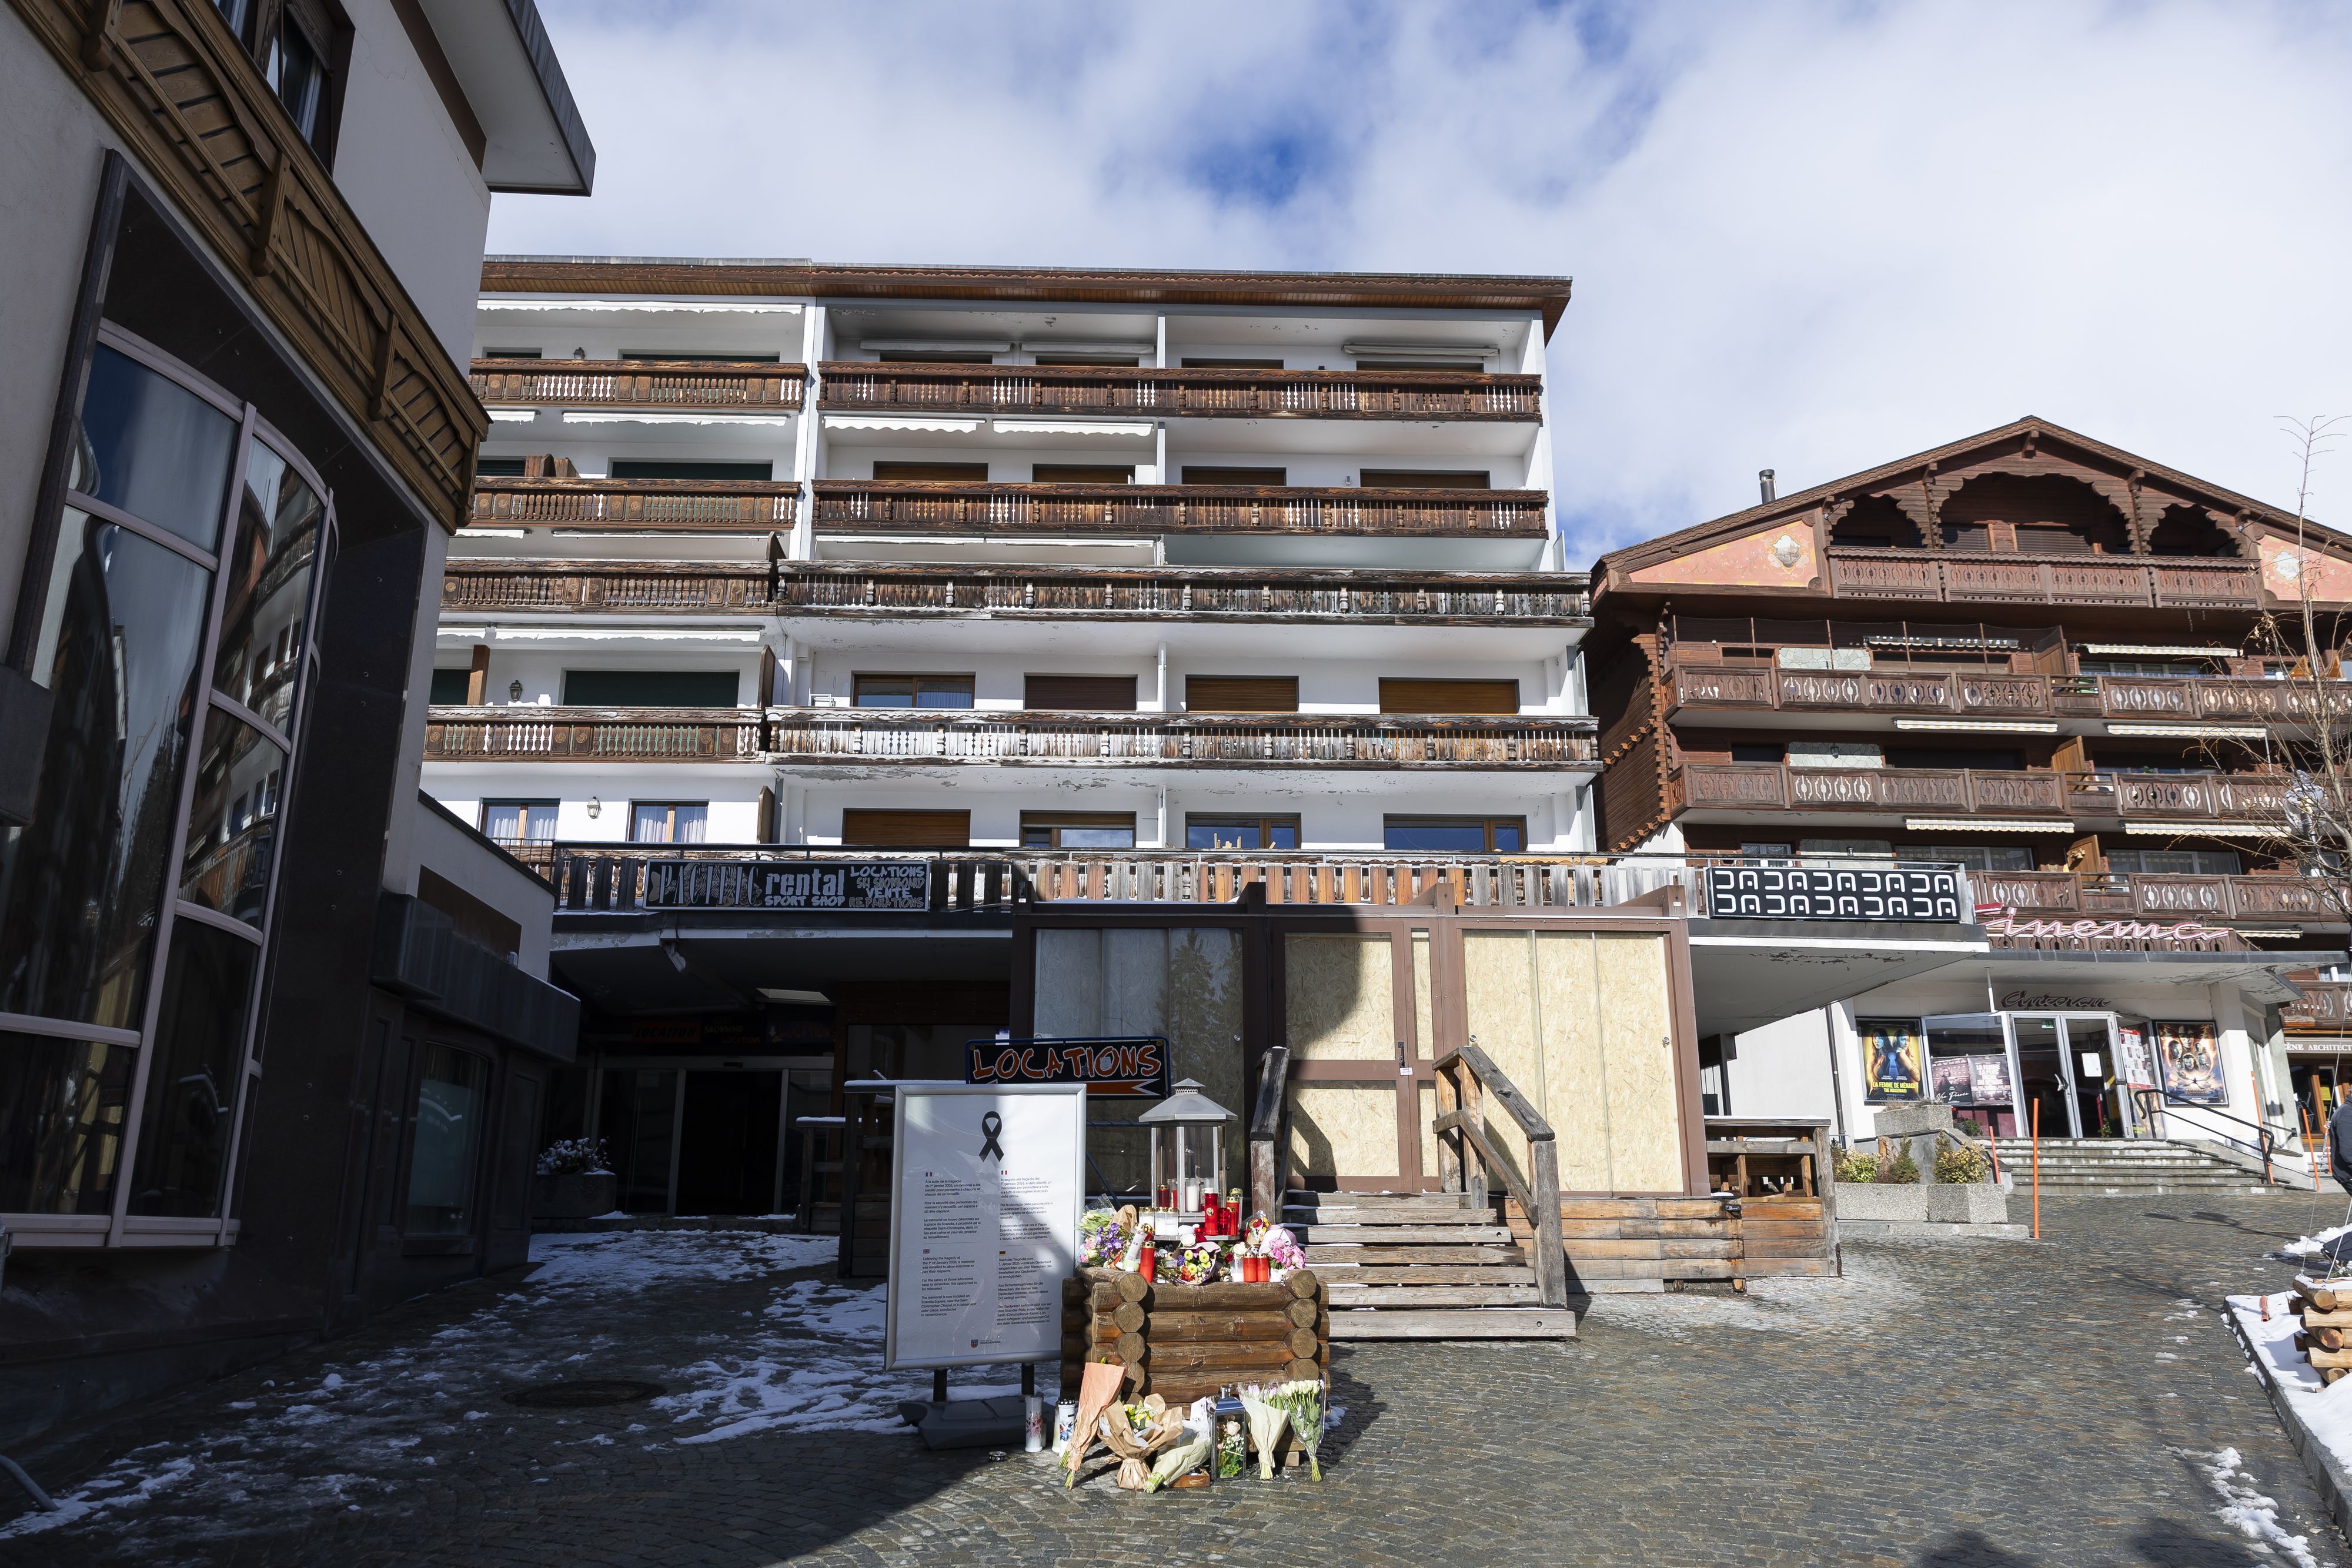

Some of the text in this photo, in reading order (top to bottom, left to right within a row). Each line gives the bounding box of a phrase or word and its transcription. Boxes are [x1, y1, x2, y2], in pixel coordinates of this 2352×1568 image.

[850, 865, 926, 877] LOCATIONS
[659, 865, 759, 905] PACIFIC
[766, 868, 845, 895] rental
[856, 877, 926, 889] SKI SNOWBOARD
[866, 887, 913, 898] VENTE
[764, 895, 846, 906] SPORT SHOP
[848, 897, 924, 908] REPARATIONS
[973, 1045, 1162, 1079] LOCATIONS
